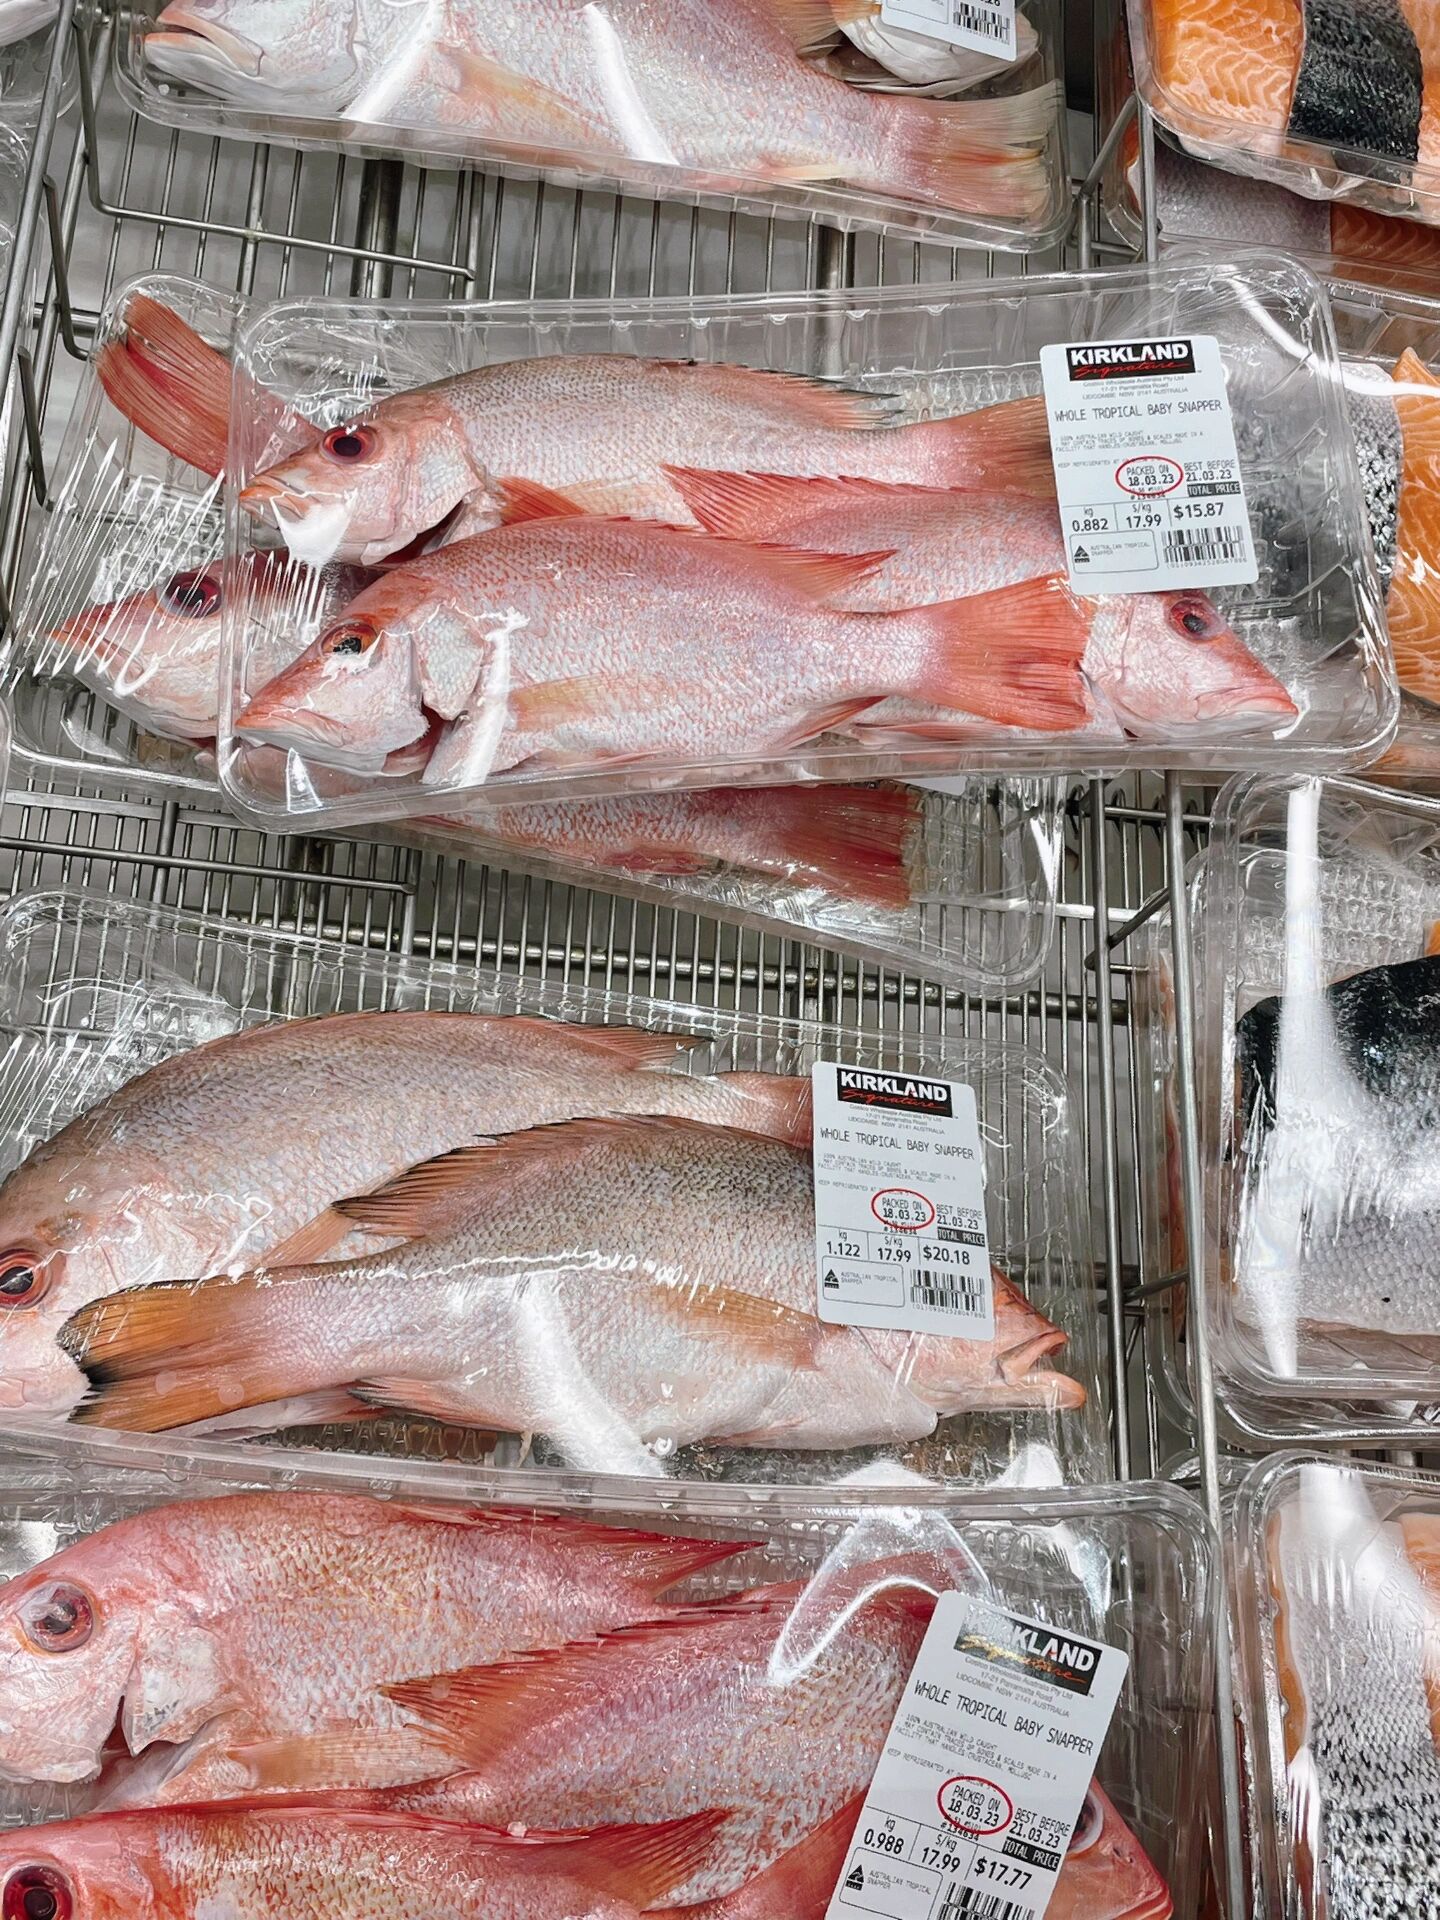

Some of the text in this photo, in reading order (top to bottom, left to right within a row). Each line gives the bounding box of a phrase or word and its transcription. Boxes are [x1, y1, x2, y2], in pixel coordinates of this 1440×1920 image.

[1070, 342, 1189, 365] KIRKLAND
[1072, 358, 1190, 379] Signature
[1054, 399, 1222, 421] WHOLE TROPICAL BABY SNAPPER
[1126, 464, 1169, 475] PACKED ON
[1184, 459, 1235, 471] BEST BEFORE
[1127, 473, 1174, 486] 18.03.23
[1185, 469, 1232, 481] 21.03.23
[1187, 482, 1240, 496] TOTAL PRICE
[1083, 506, 1093, 516] kg
[1132, 502, 1152, 513] $/kg
[1173, 502, 1225, 519] $15.87
[1071, 518, 1109, 532] 0.882
[1126, 514, 1162, 528] 17.99
[840, 1070, 947, 1103] KIRKLAND
[842, 1086, 947, 1115] Signature
[820, 1126, 974, 1160] WHOLE TROPICAL BABY SNAPPER
[882, 1196, 922, 1211] PACKED ON
[936, 1204, 982, 1219] BEST BEFORE
[883, 1206, 926, 1223] 18.03.23
[936, 1214, 978, 1230] 21.03.23
[838, 1229, 847, 1240] kg
[884, 1236, 902, 1247] $/kg
[937, 1228, 985, 1246] TOTAL PRICE
[826, 1240, 860, 1257] 1.122
[877, 1246, 911, 1263] 17.99
[922, 1245, 970, 1266] $20.18
[965, 1608, 1097, 1674] KKLAND
[1031, 1698, 1070, 1718] AUSTRALIA
[913, 1680, 1095, 1756] WHOLE TROPICAL BABY SNAPPER
[952, 1784, 1001, 1812] PACKED ON
[946, 1797, 1000, 1827] 18.03.23
[883, 1815, 897, 1831] kg
[1014, 1807, 1070, 1837] BEST BEFORE
[862, 1827, 905, 1856] 0.988
[934, 1832, 959, 1851] $/kg
[1008, 1820, 1061, 1849] 21.03.23
[919, 1846, 962, 1874] 17.99
[1001, 1837, 1061, 1870] TOTAL PRICE
[972, 1855, 1033, 1892] $17.77
